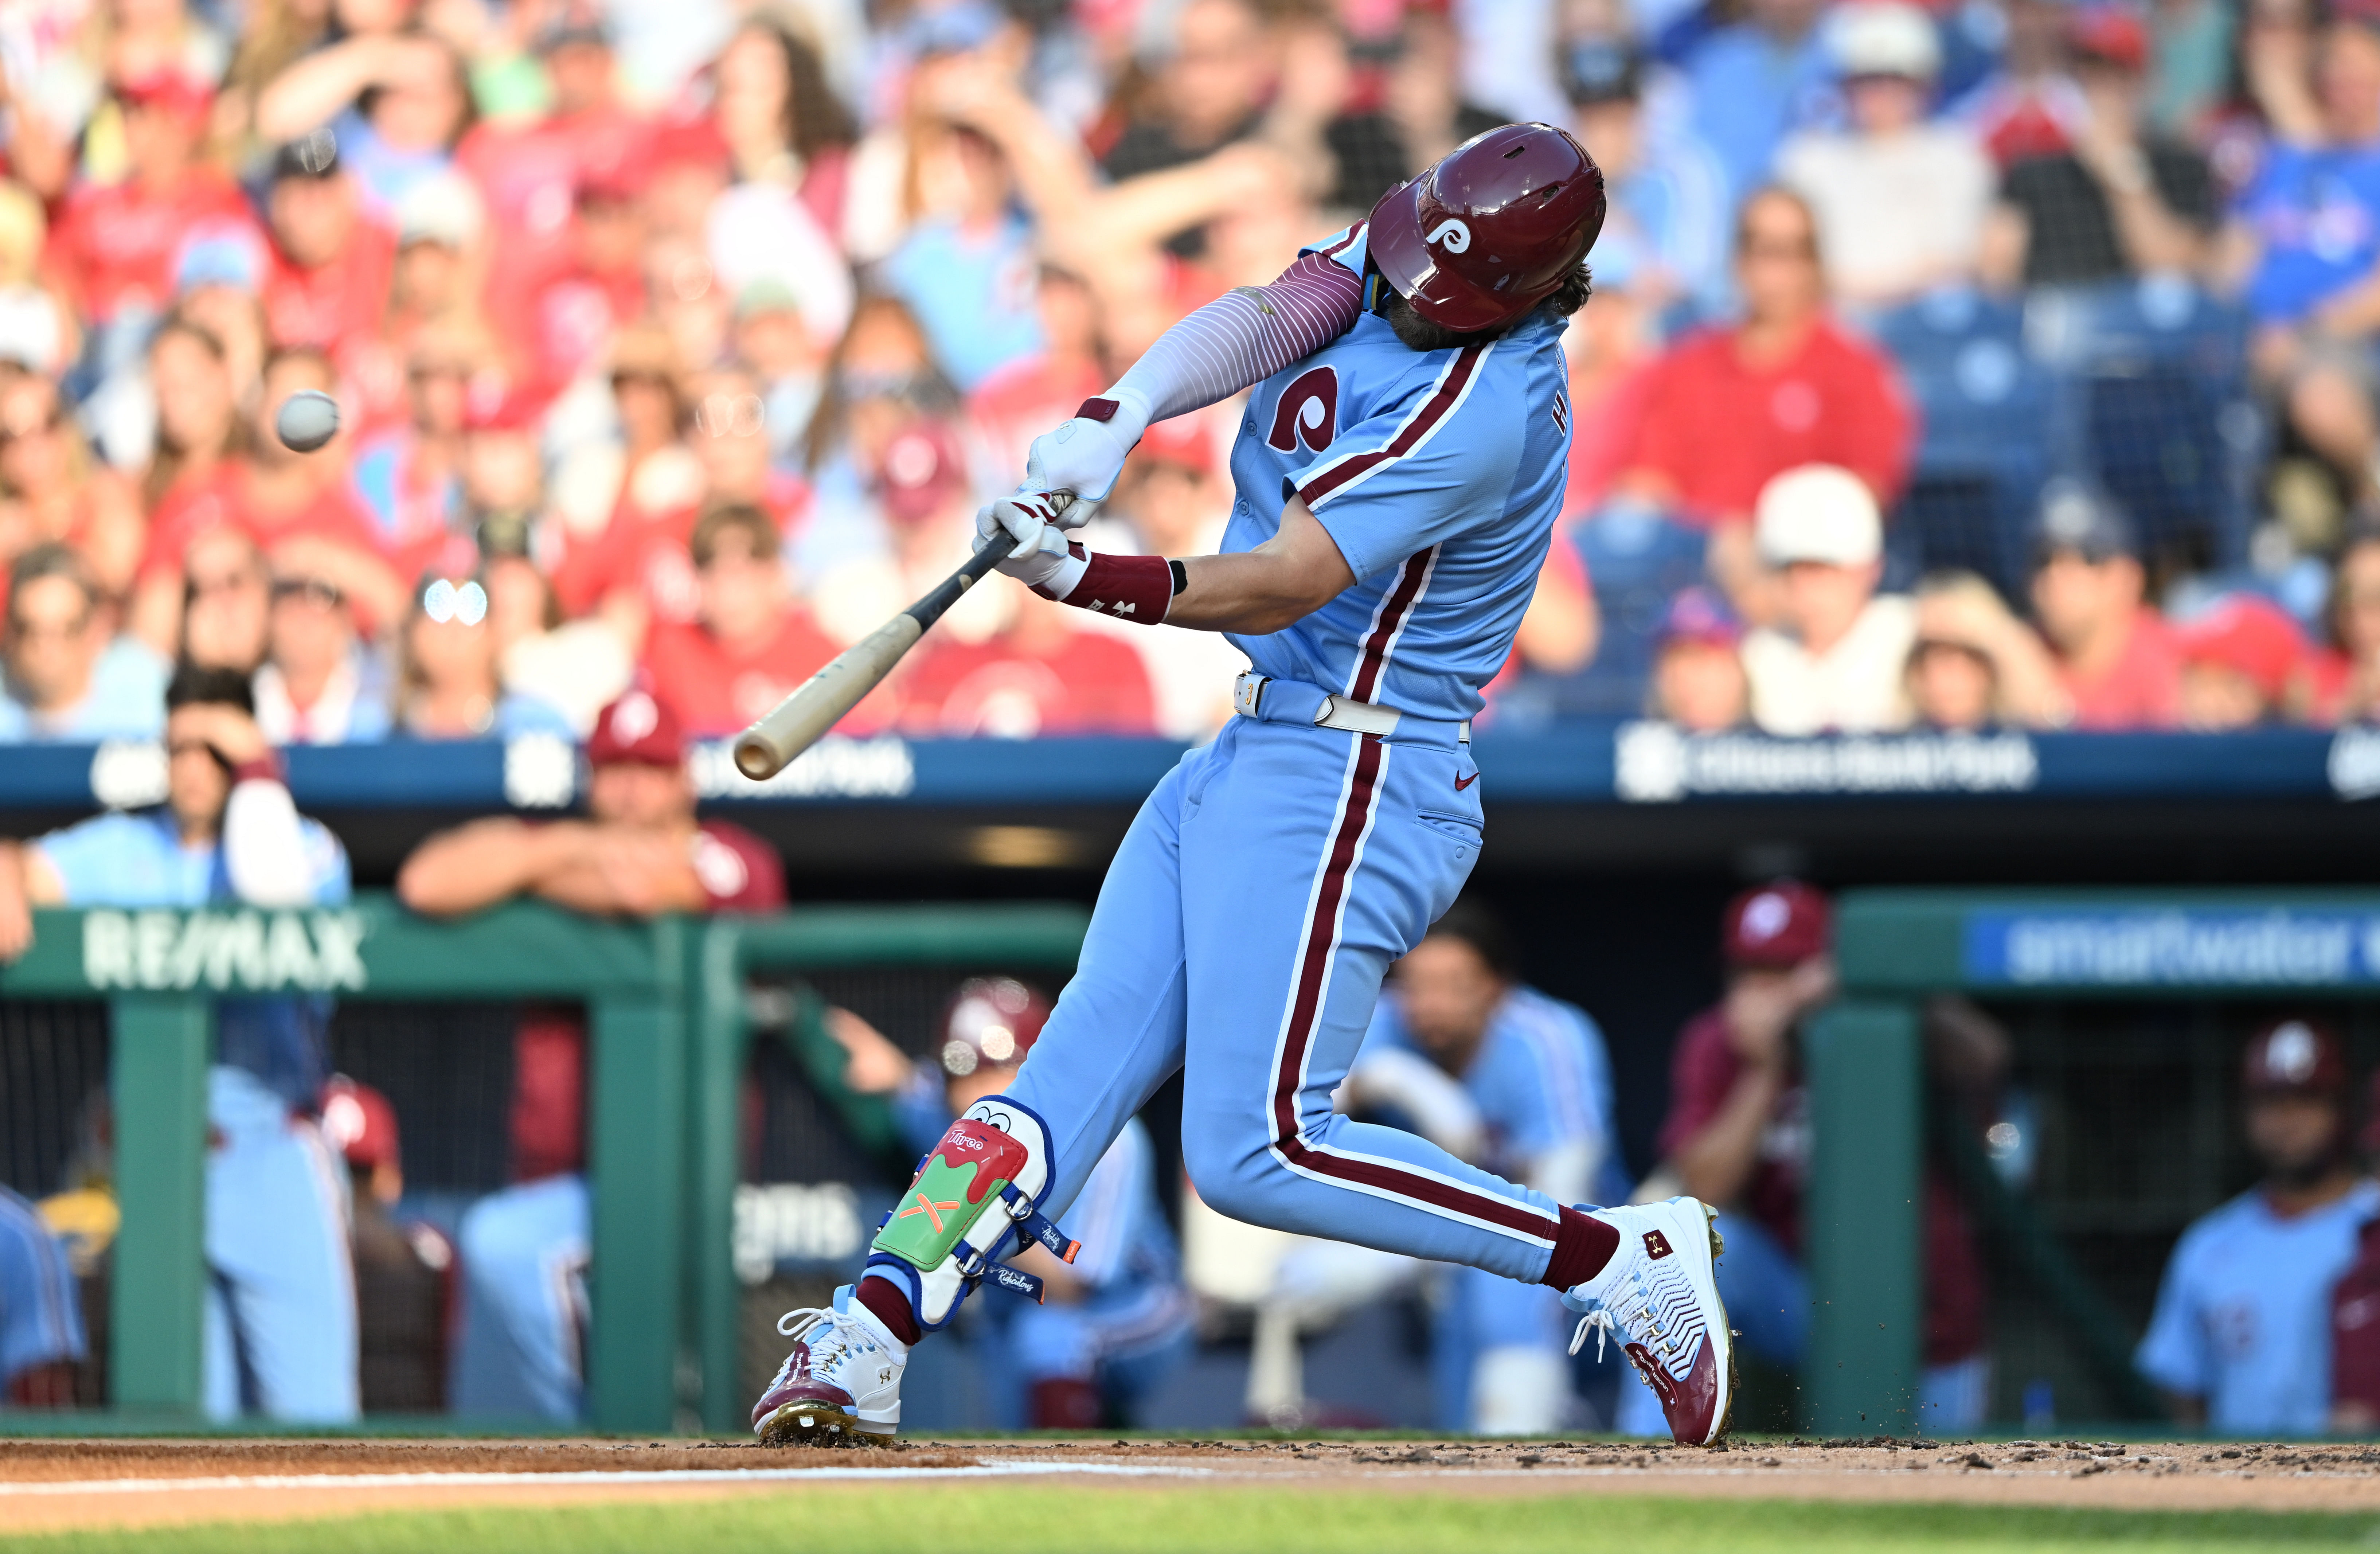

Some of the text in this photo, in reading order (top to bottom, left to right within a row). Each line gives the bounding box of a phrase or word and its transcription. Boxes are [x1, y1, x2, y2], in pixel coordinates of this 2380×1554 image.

[1245, 683, 1254, 706] 3
[83, 907, 369, 992] RE/MAX
[947, 1129, 984, 1150] Three
[998, 1269, 1034, 1292] Ridiculous
[1635, 1349, 1669, 1392] UNDER ARMOUR
